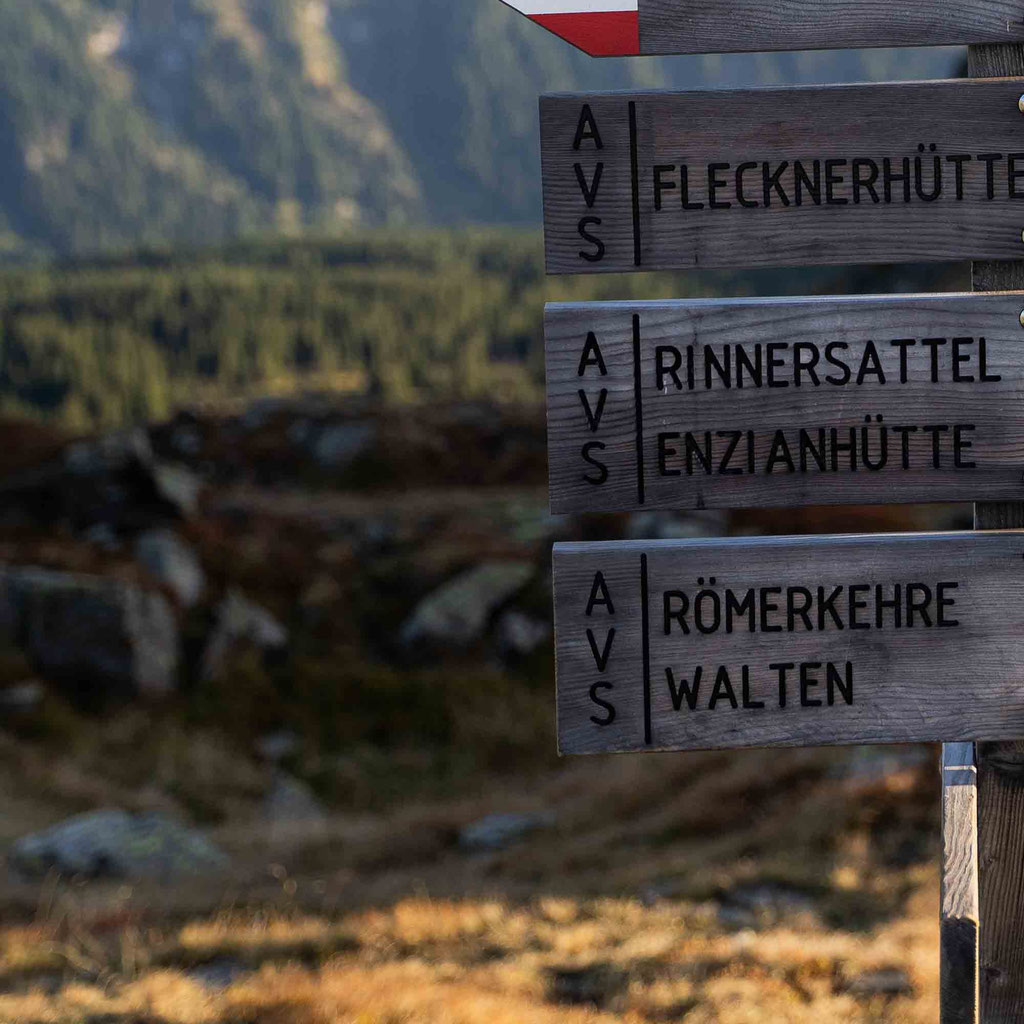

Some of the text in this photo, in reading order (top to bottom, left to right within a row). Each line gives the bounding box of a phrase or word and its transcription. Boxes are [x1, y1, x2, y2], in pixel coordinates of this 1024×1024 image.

[655, 337, 1001, 391] RINNERSATTEL
[657, 414, 976, 476] ENZIANHÜTTE
[663, 578, 960, 636] RÖMERKEHRE
[665, 661, 854, 711] WALTEN
